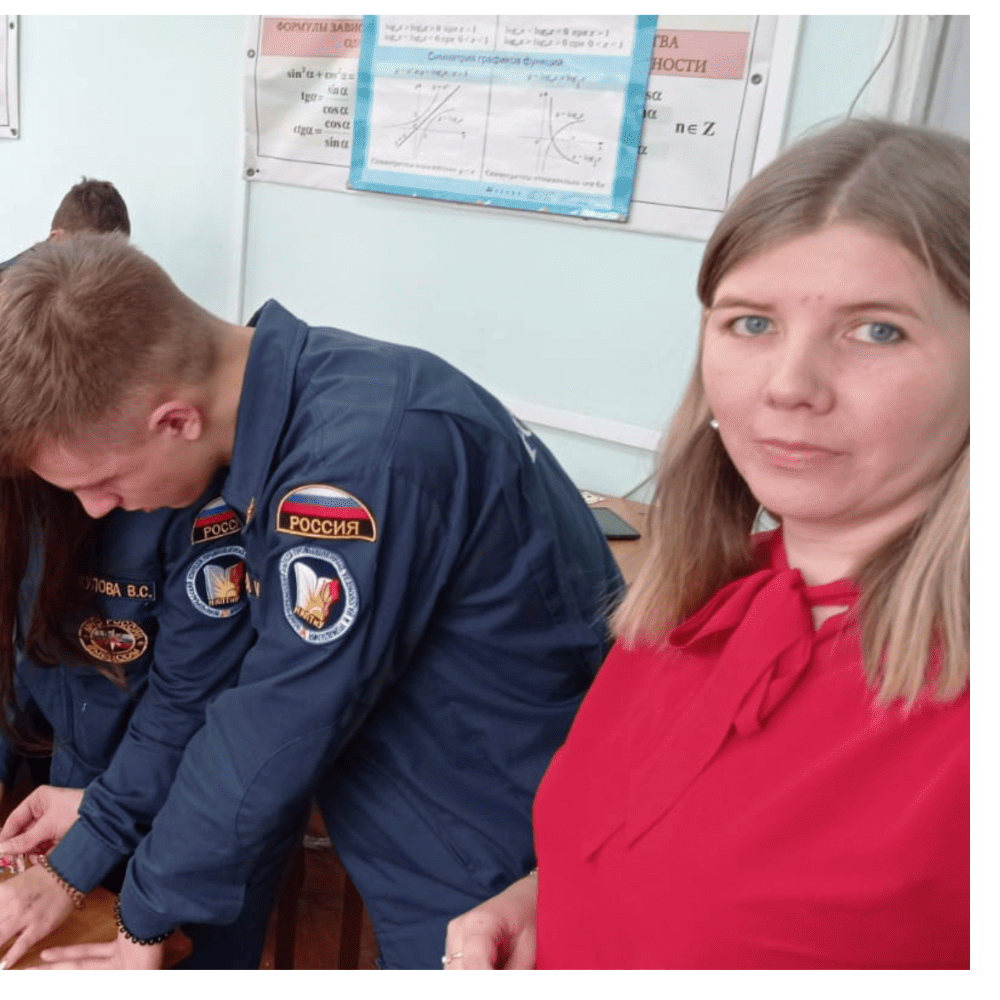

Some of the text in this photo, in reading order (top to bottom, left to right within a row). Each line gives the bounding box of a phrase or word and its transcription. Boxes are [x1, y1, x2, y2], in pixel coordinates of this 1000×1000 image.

[276, 21, 328, 33] ФОРМУЛЫ
[203, 520, 241, 538] РОСС
[289, 516, 360, 535] РОССИЯ
[82, 576, 153, 598] УЛОВА В.С.
